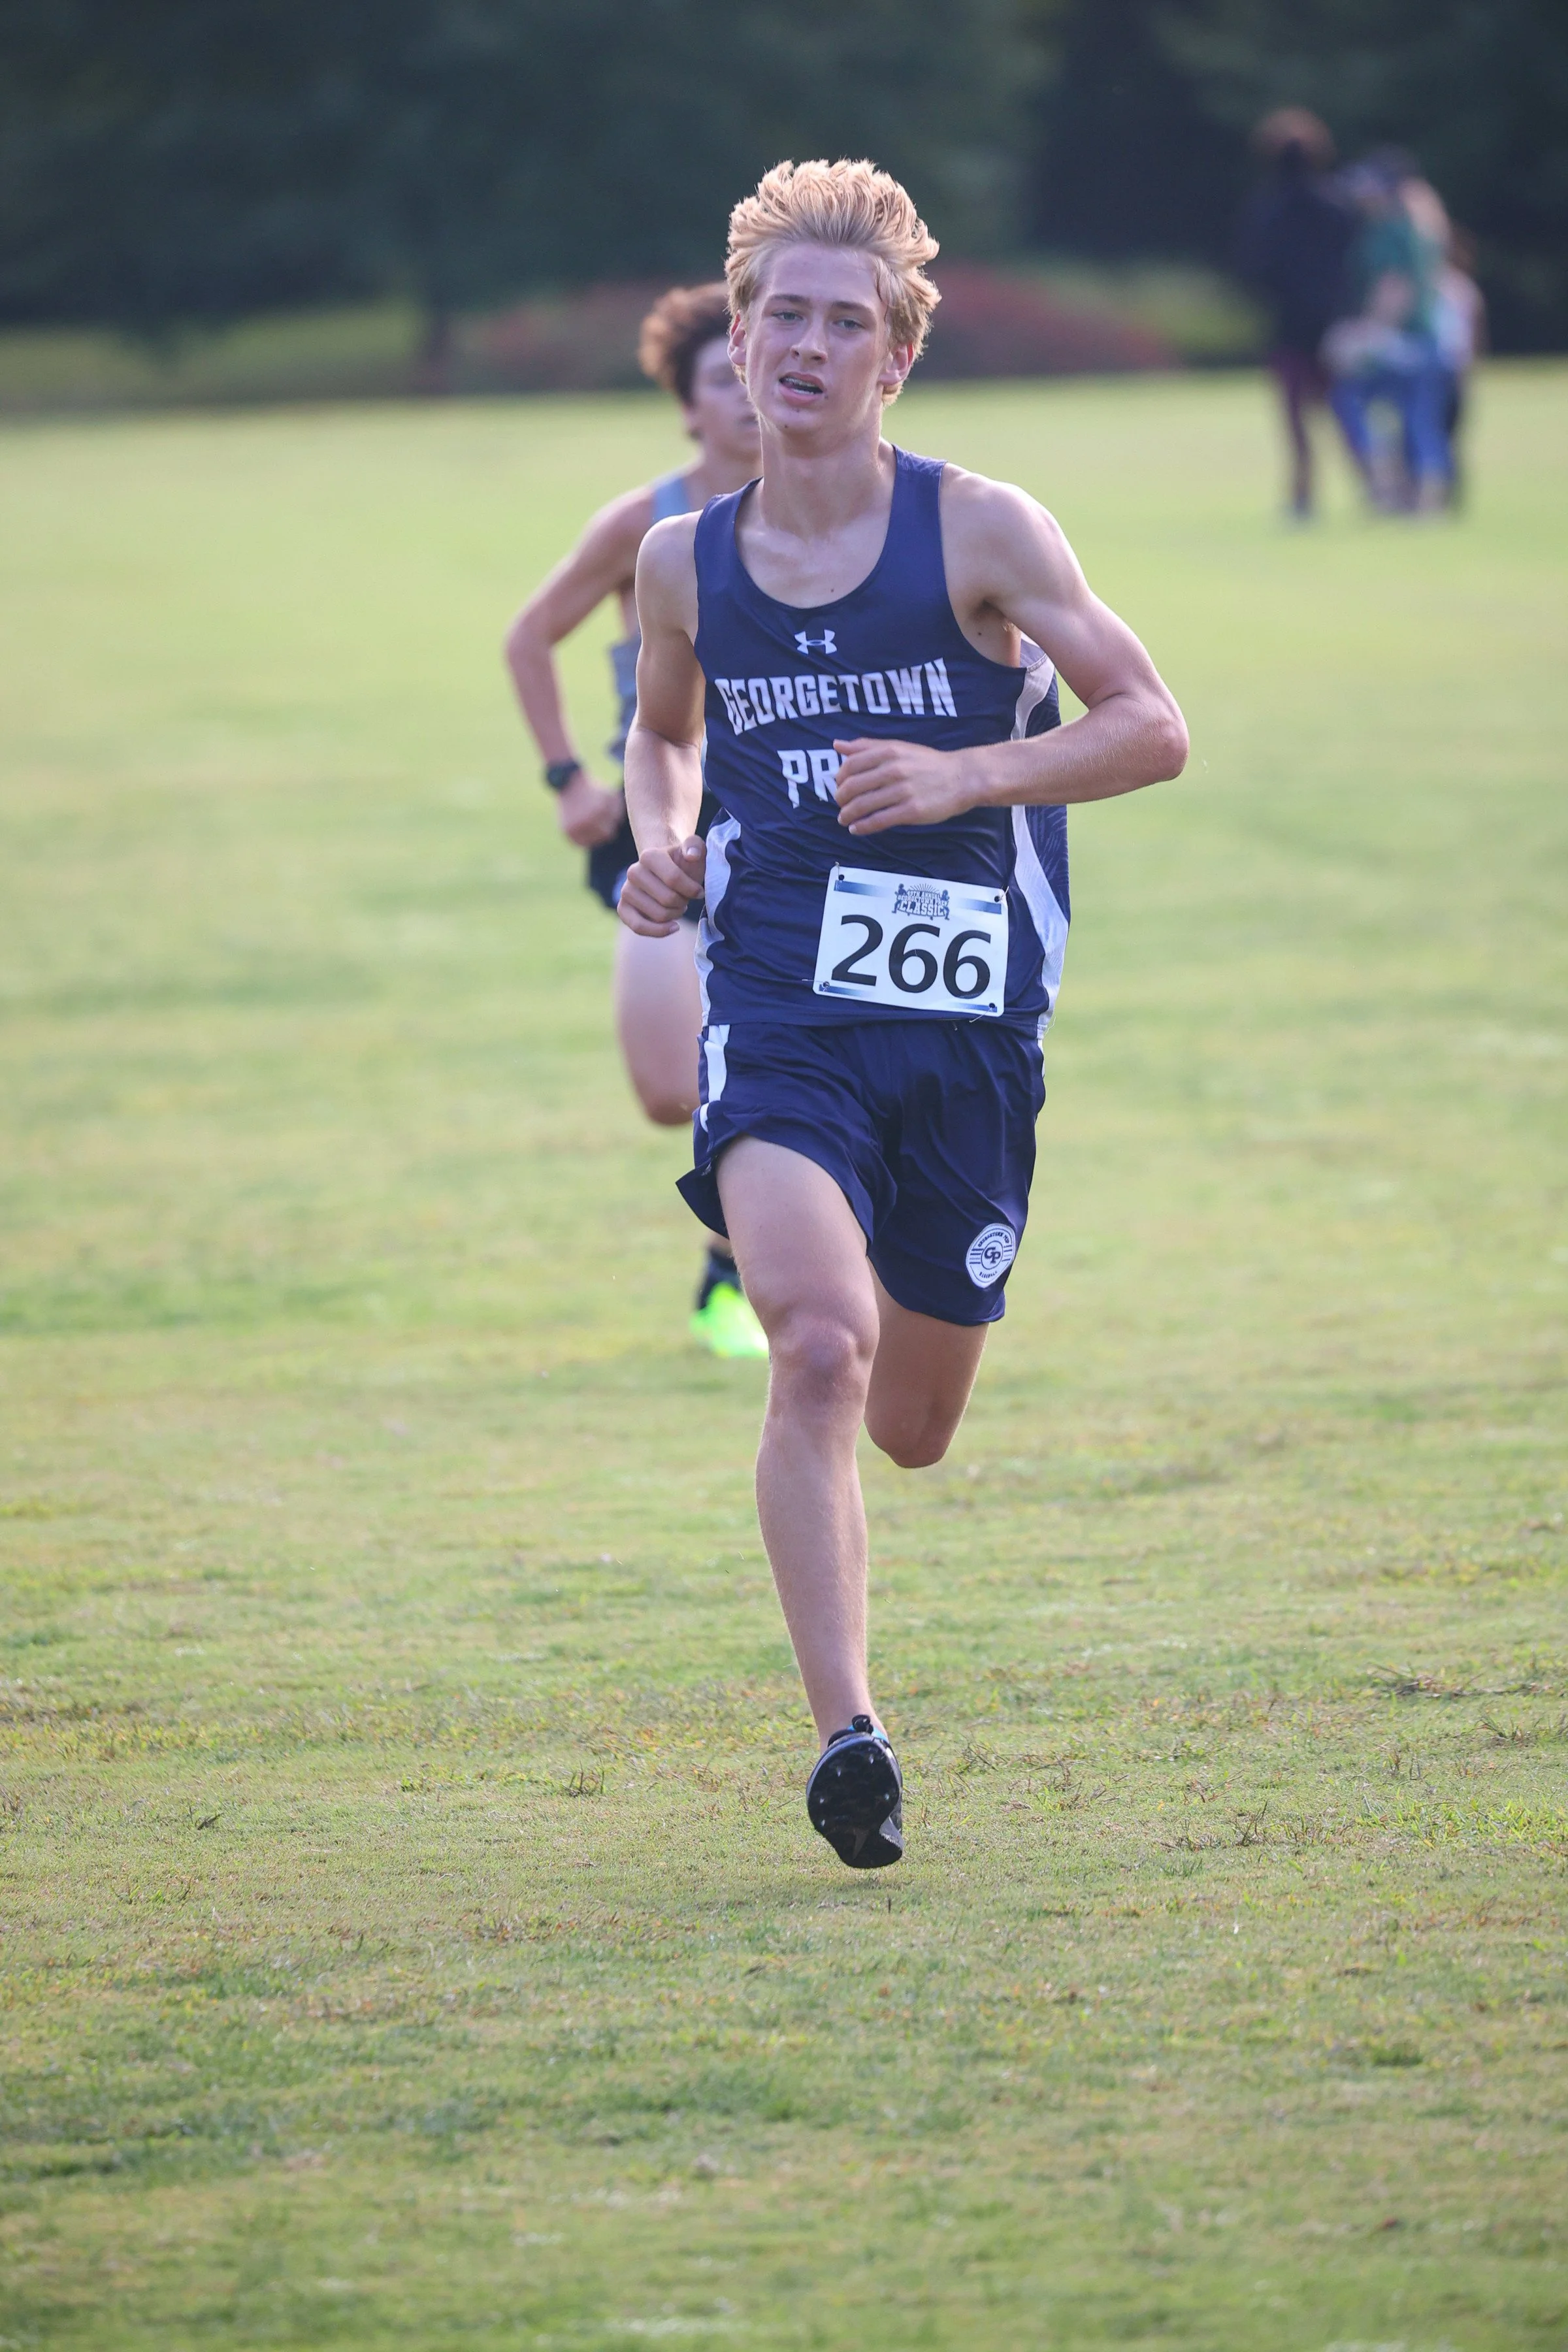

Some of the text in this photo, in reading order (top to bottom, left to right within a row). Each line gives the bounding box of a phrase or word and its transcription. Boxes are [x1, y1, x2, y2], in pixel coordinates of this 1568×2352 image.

[714, 657, 958, 736] GEORGETOWN
[777, 749, 847, 809] PR
[899, 900, 944, 916] CLASSIC
[831, 914, 992, 1000] 266
[984, 1246, 1002, 1264] GP
